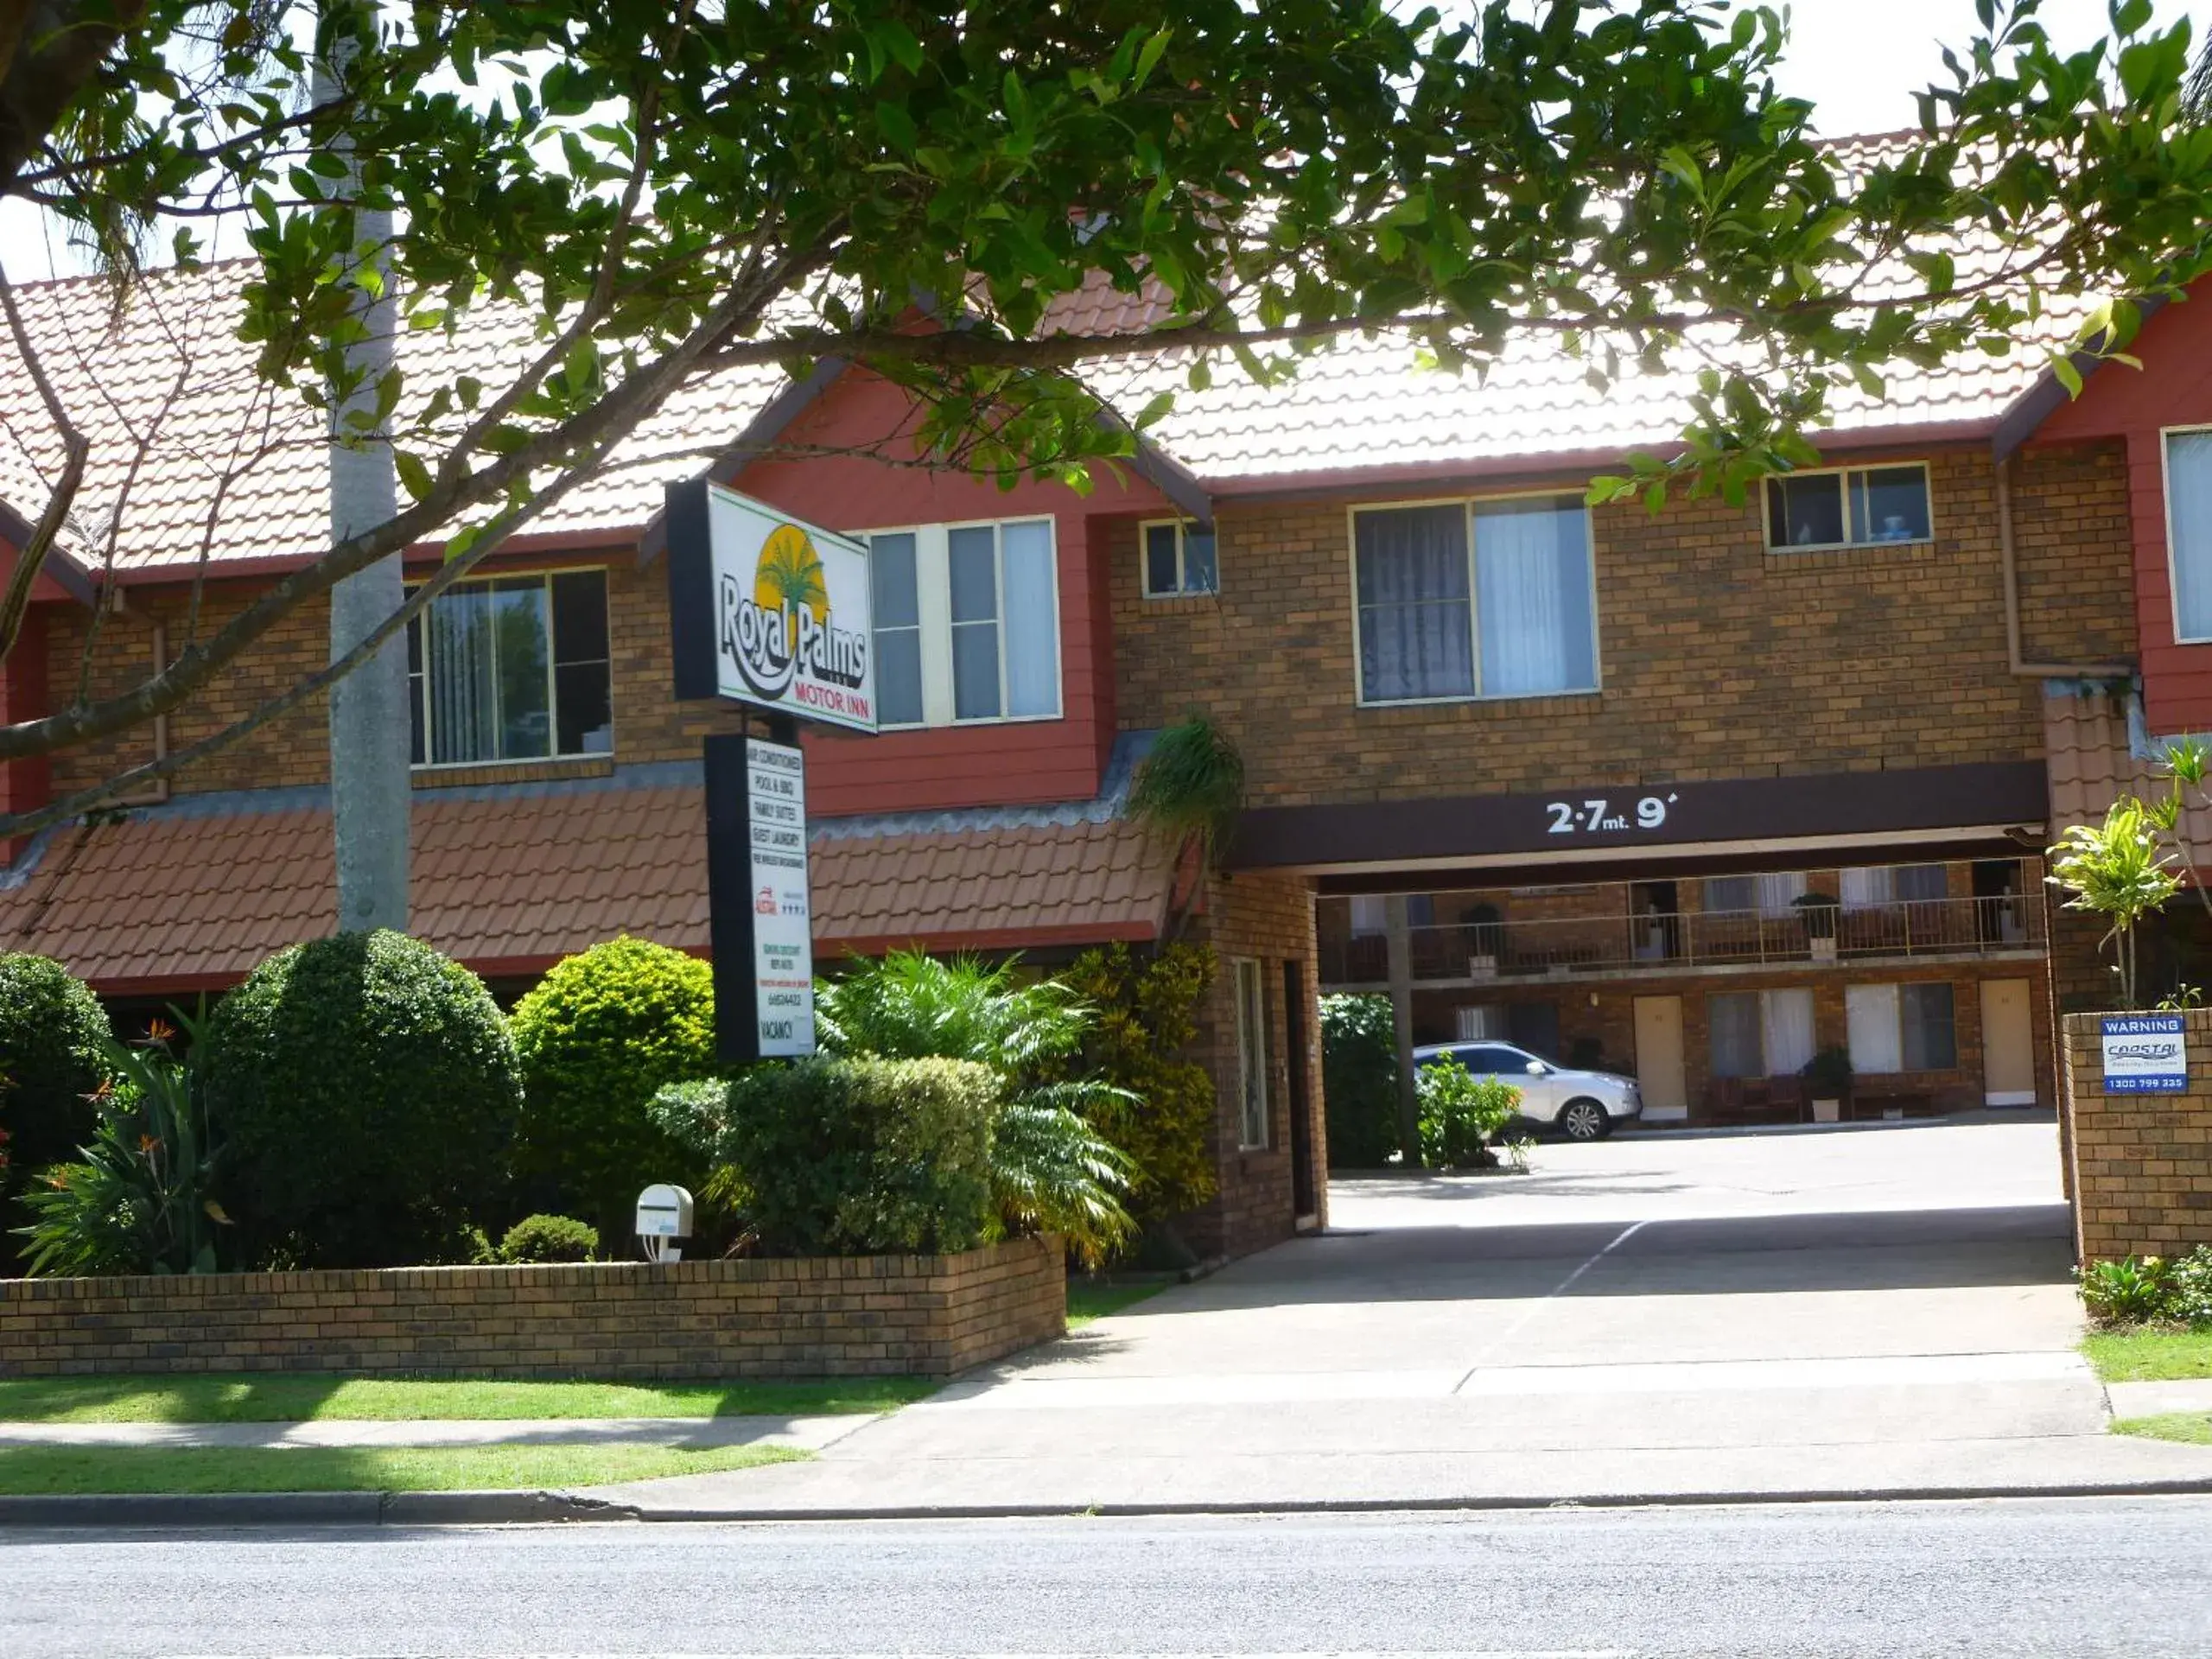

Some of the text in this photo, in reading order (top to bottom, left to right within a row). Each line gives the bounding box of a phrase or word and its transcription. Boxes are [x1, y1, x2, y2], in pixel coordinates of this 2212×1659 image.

[721, 573, 864, 701] Royal Palms
[795, 682, 869, 718] MOTOR INN
[760, 1020, 793, 1039] VACANCY
[2105, 1020, 2178, 1033] WARNING
[2107, 1043, 2177, 1057] COASTAL
[2109, 1079, 2136, 1089] 1300
[2139, 1078, 2159, 1089] 799
